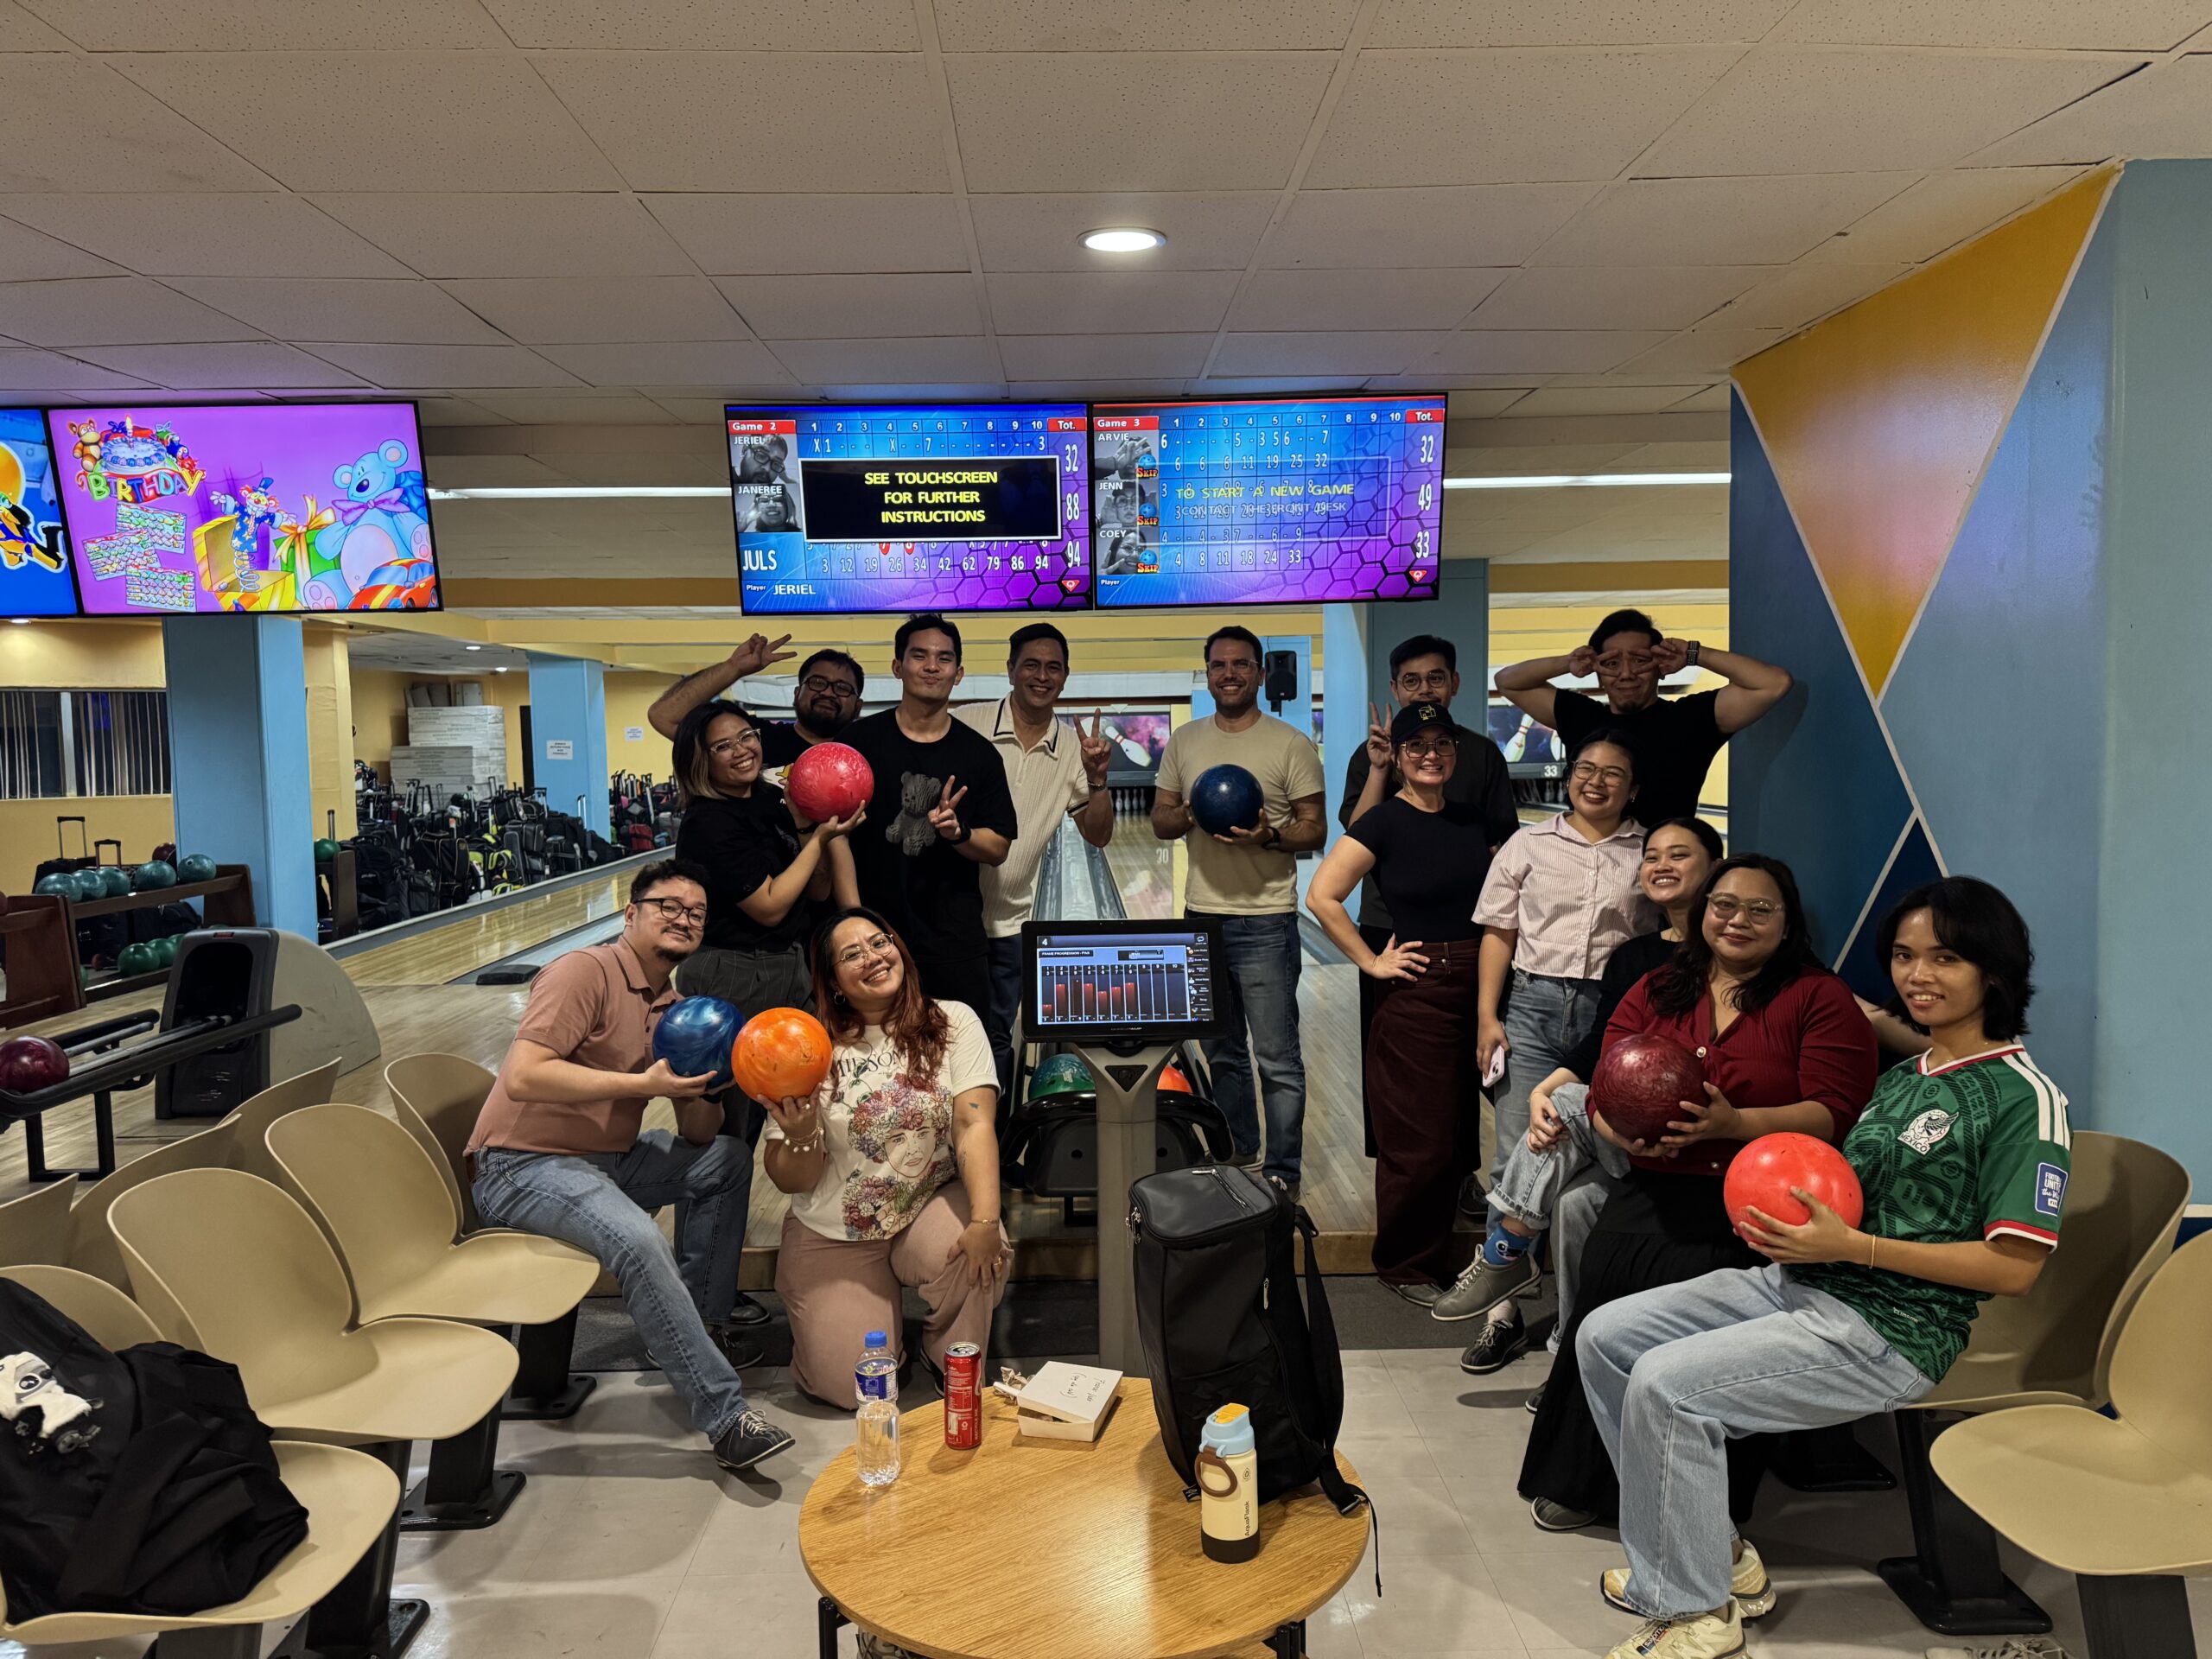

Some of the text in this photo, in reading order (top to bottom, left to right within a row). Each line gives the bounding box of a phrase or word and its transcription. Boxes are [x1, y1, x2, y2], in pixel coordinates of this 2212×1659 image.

[1134, 418, 1140, 427] 3
[1173, 418, 1179, 427] 1
[1198, 418, 1205, 427] 2
[1223, 417, 1229, 426] 3
[1247, 417, 1253, 426] 4
[1272, 416, 1279, 425] 5
[1320, 415, 1326, 423] 7
[1345, 414, 1352, 423] 8
[1370, 413, 1376, 422] 9
[1389, 412, 1401, 422] 10
[1415, 412, 1433, 421] Tot.
[733, 422, 777, 431] Game 2
[811, 420, 1042, 431] 1 2 3 4 5 6 7 8 9 10
[1057, 421, 1076, 429] Tot.
[734, 435, 764, 445] JERIEL
[814, 435, 1046, 453] X 1 X 7 3
[1098, 433, 1129, 442] ARVIE
[1161, 430, 1328, 448] 6 5 3 5 6 7
[1420, 435, 1433, 463] 32
[1065, 444, 1078, 472] 32
[1175, 453, 1327, 471] 6 6 6 11 19 25 32
[864, 471, 998, 485] SEE TOUCHSCREEN
[1135, 467, 1158, 477] SKIP
[87, 469, 203, 503] BIRTHDAY
[738, 486, 782, 494] JANEREE
[1161, 483, 1167, 498] 3
[1175, 484, 1354, 499] TO START A NEW GAME
[884, 491, 980, 504] FOR FURTHER
[1418, 484, 1433, 512] 49
[1066, 493, 1079, 520] 88
[1175, 505, 1181, 519] 3
[1181, 505, 1236, 516] CONTACT
[880, 510, 986, 524] INSTRUCTIONS
[1136, 516, 1158, 525] SKIP
[1099, 530, 1127, 538] COEY
[1161, 527, 1302, 544] 4 4 3 7 6 9
[1416, 531, 1430, 558] 33
[742, 550, 777, 571] JULS
[1067, 541, 1080, 568] 94
[1175, 550, 1301, 566] 4 8 11 18 24 33
[822, 556, 1048, 573] 3 12 19 26 34 42 62 79 86 94
[1137, 563, 1159, 573] SKIP
[772, 584, 817, 595] JERIEL
[1544, 765, 1557, 777] 33
[1156, 849, 1169, 864] 30
[1901, 1134, 1928, 1152] MEXICO
